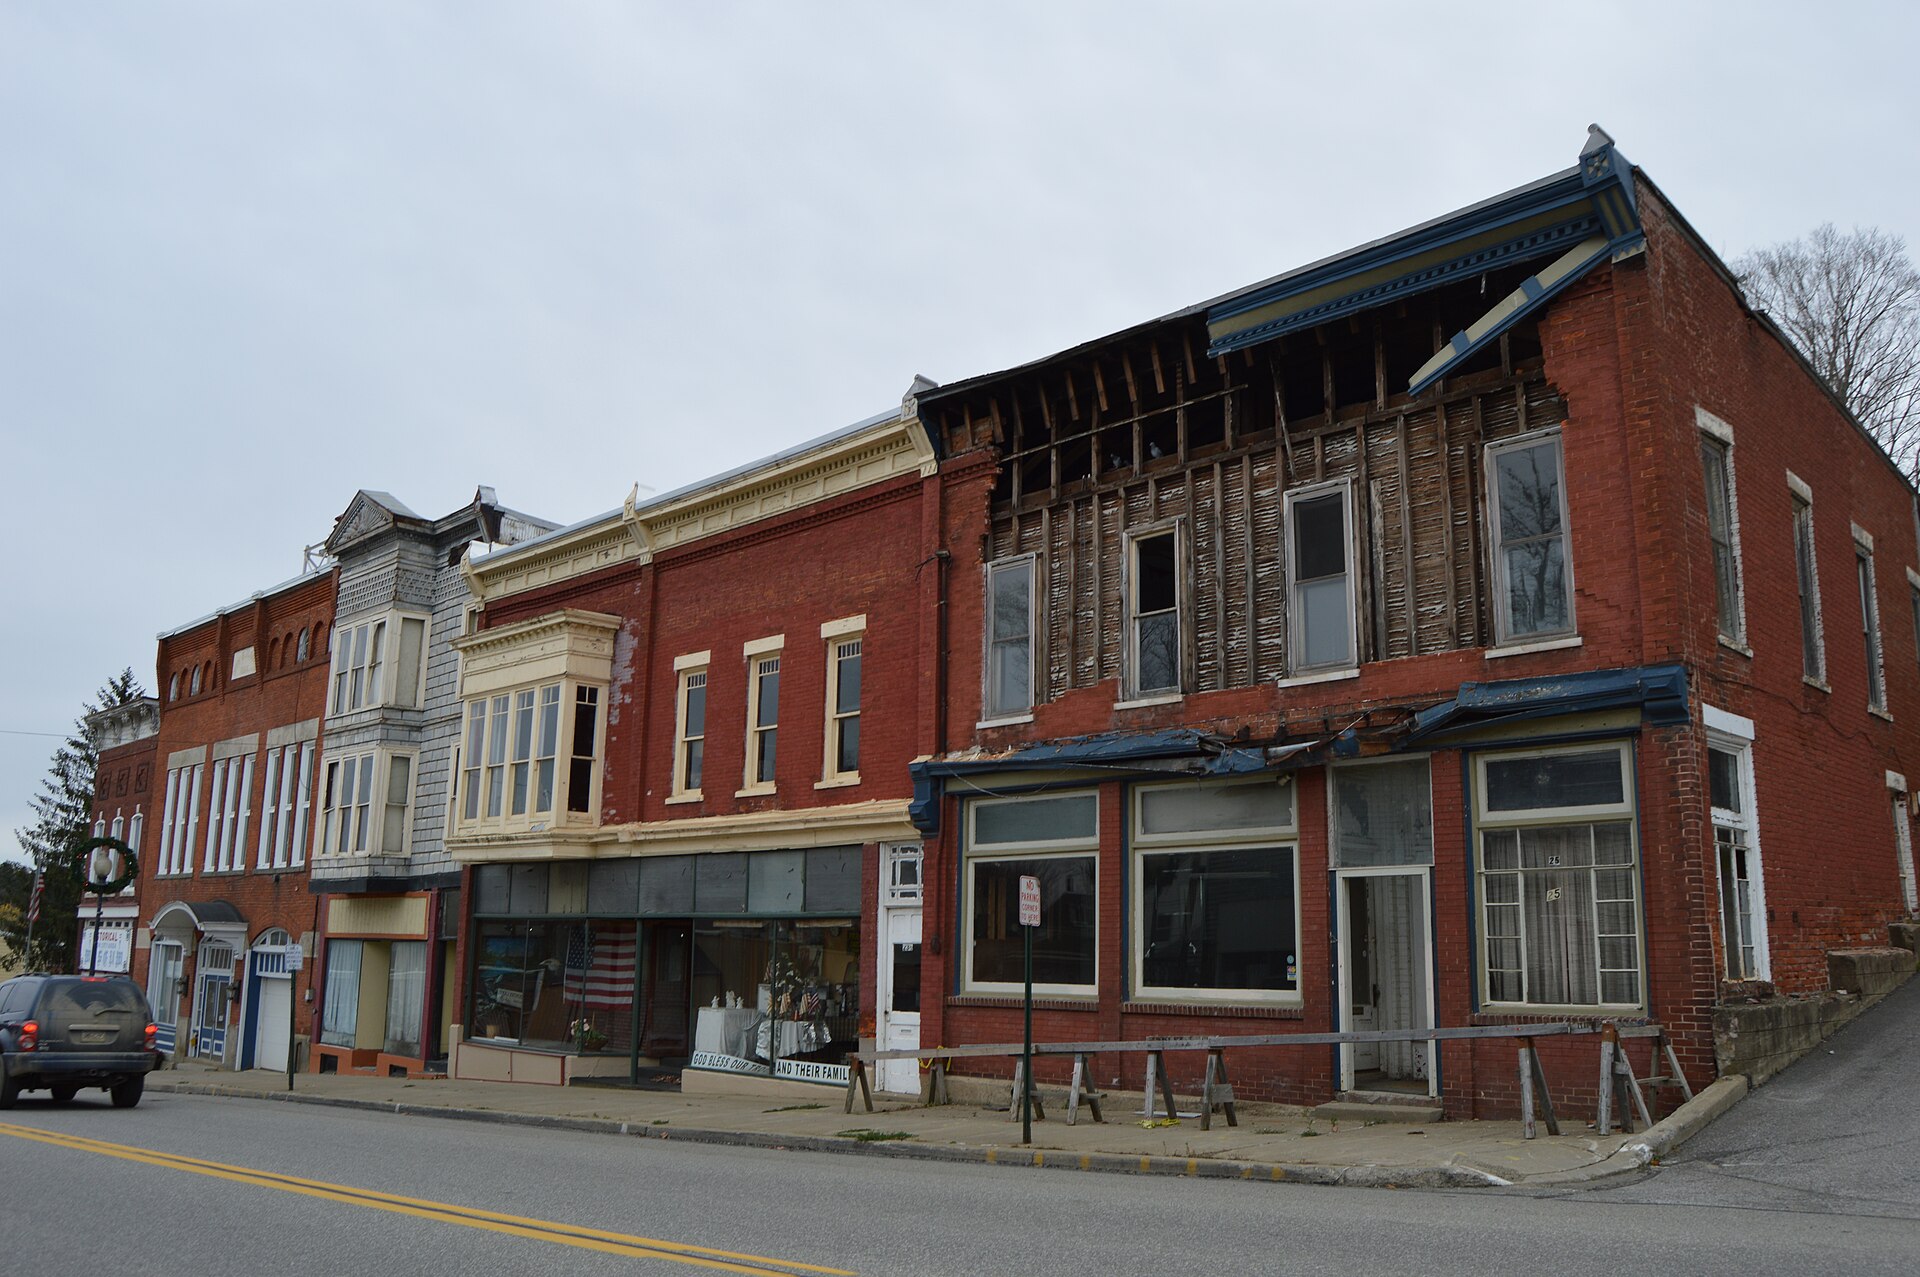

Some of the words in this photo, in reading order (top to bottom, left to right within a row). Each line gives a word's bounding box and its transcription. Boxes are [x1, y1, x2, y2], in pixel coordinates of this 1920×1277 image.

[1549, 857, 1560, 865] 25
[1026, 881, 1034, 891] NO
[1021, 892, 1039, 903] PARKING
[1547, 889, 1561, 900] 25
[1022, 904, 1038, 912] CORNER
[693, 1053, 707, 1066] GOD
[708, 1055, 730, 1067] BLESS
[730, 1059, 749, 1071] OUR
[776, 1061, 792, 1075] AND
[795, 1063, 820, 1078] THEIR
